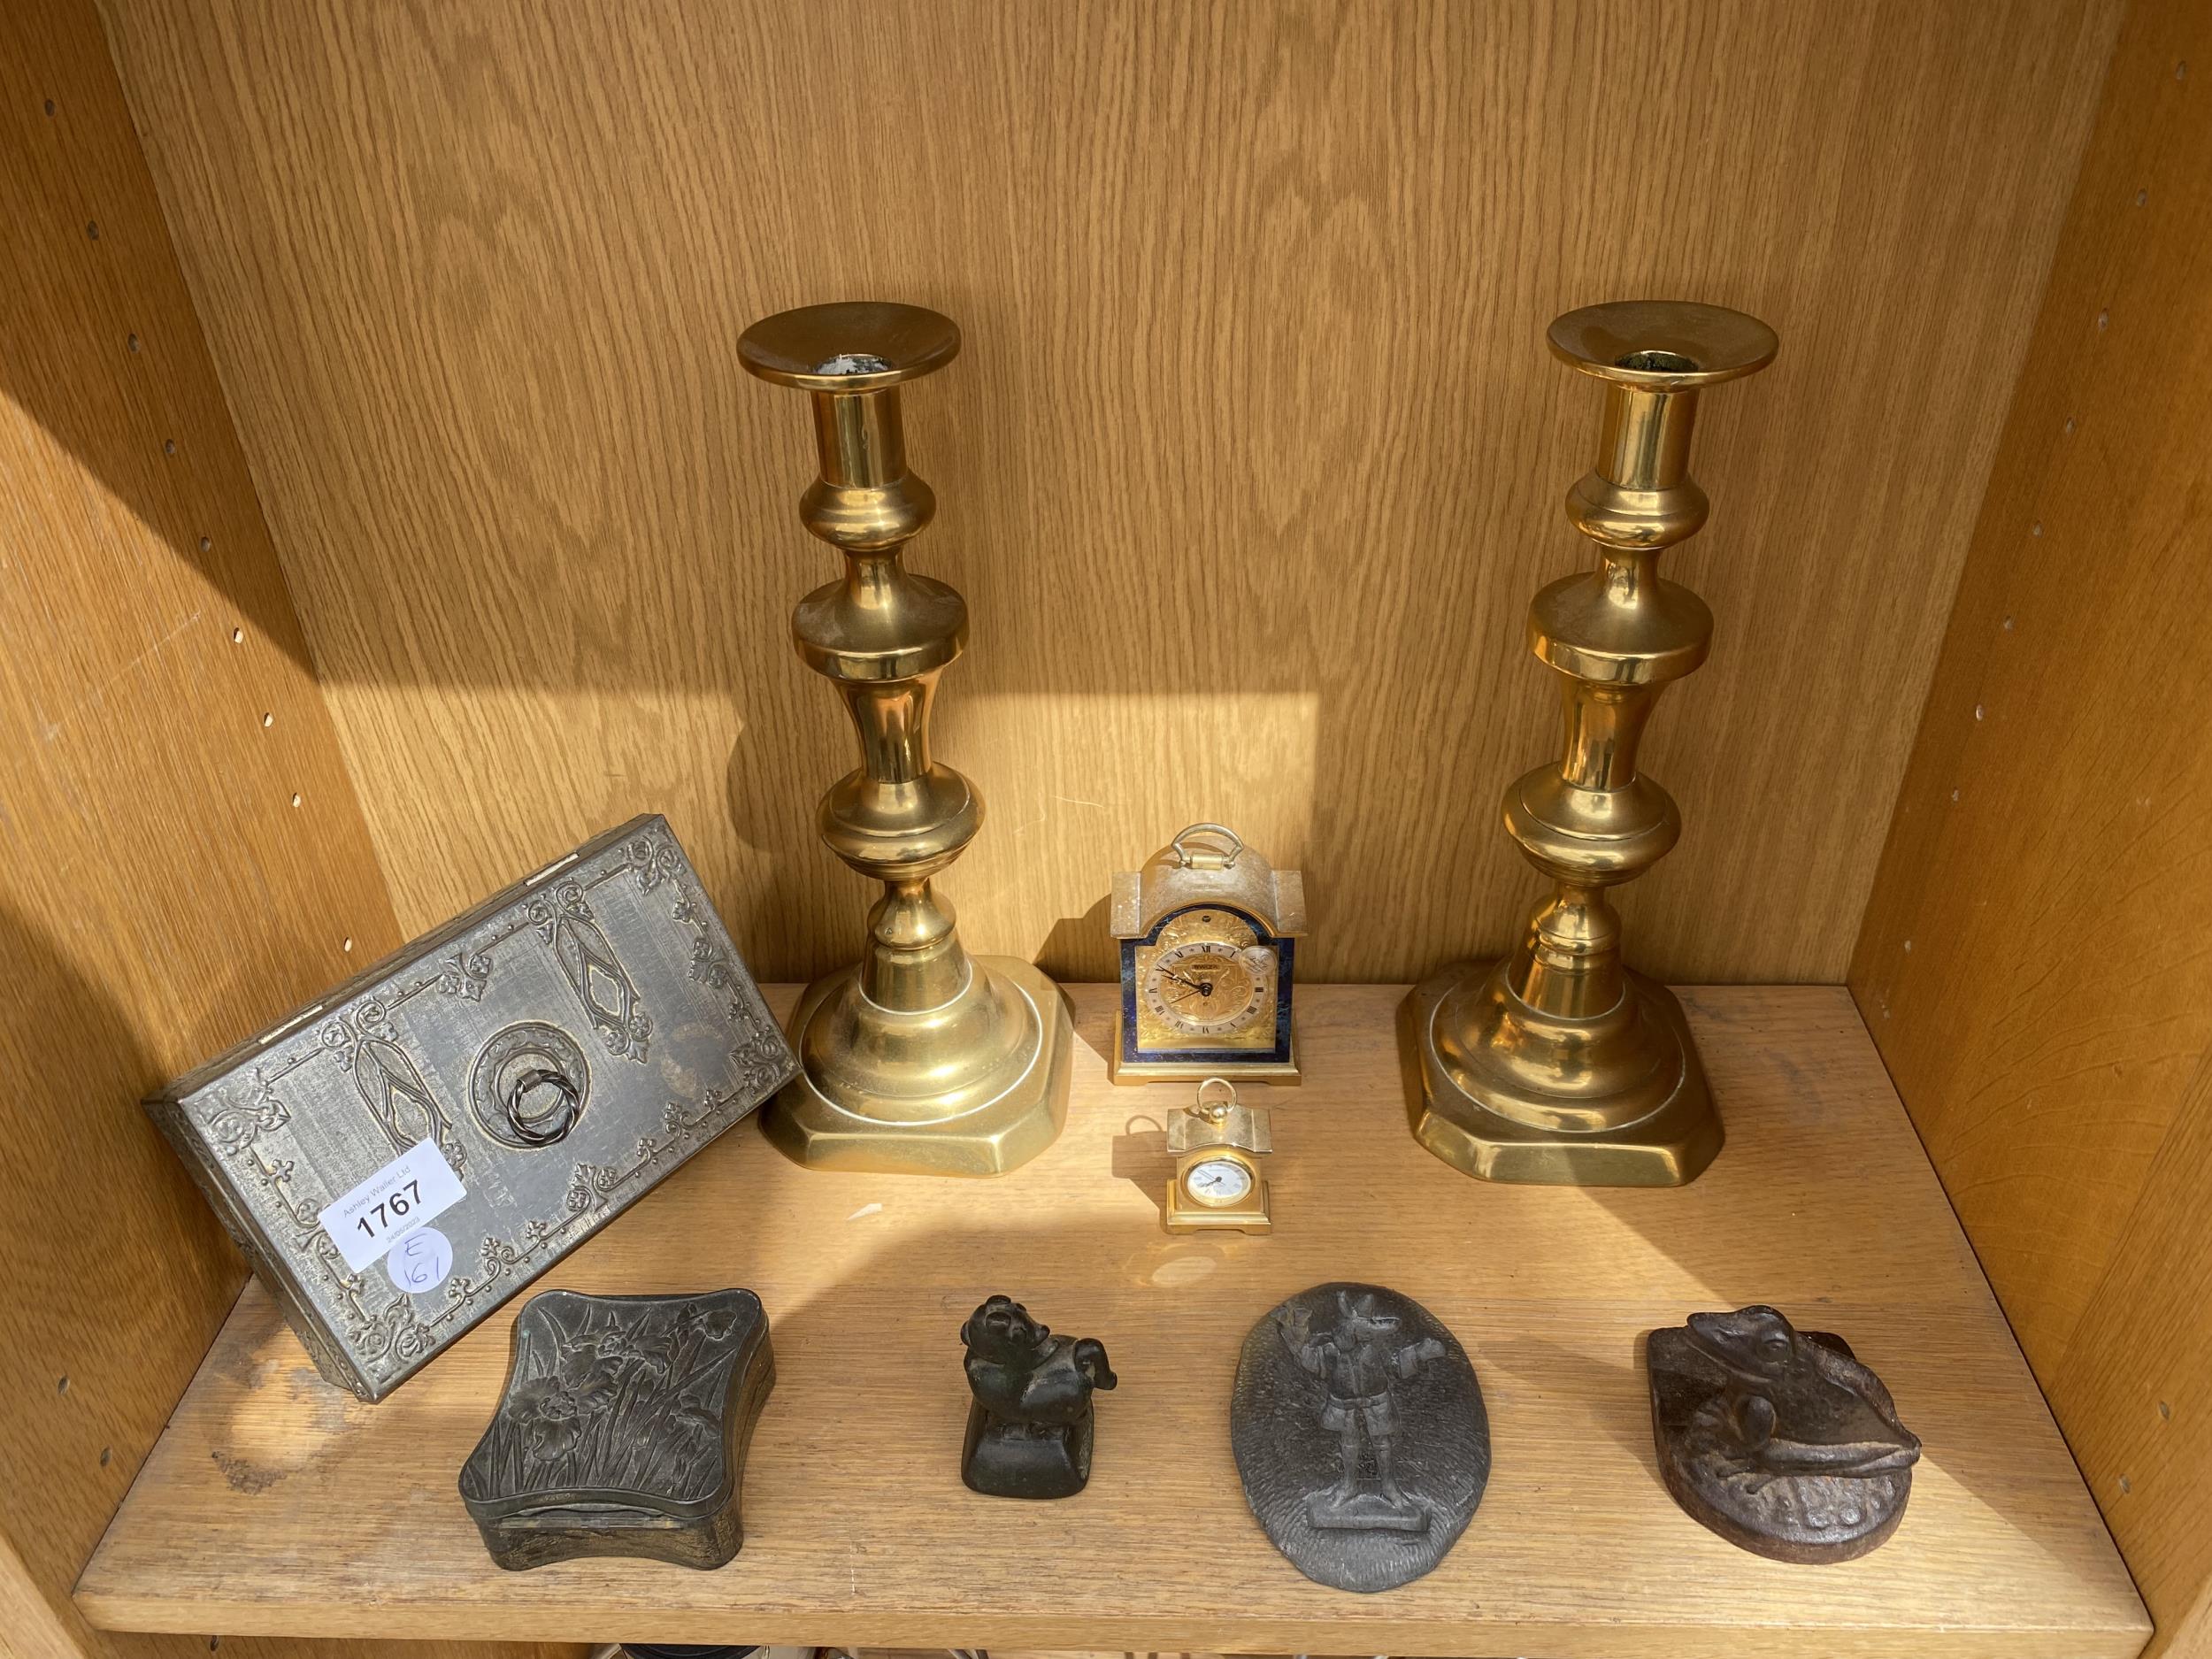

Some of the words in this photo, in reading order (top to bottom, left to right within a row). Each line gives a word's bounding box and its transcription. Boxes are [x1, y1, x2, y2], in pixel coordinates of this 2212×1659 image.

[343, 1196, 370, 1217] Ashley
[370, 1176, 396, 1196] Waller
[396, 1165, 411, 1179] Ltd
[357, 1179, 421, 1238] 1767
[404, 1233, 427, 1256] E
